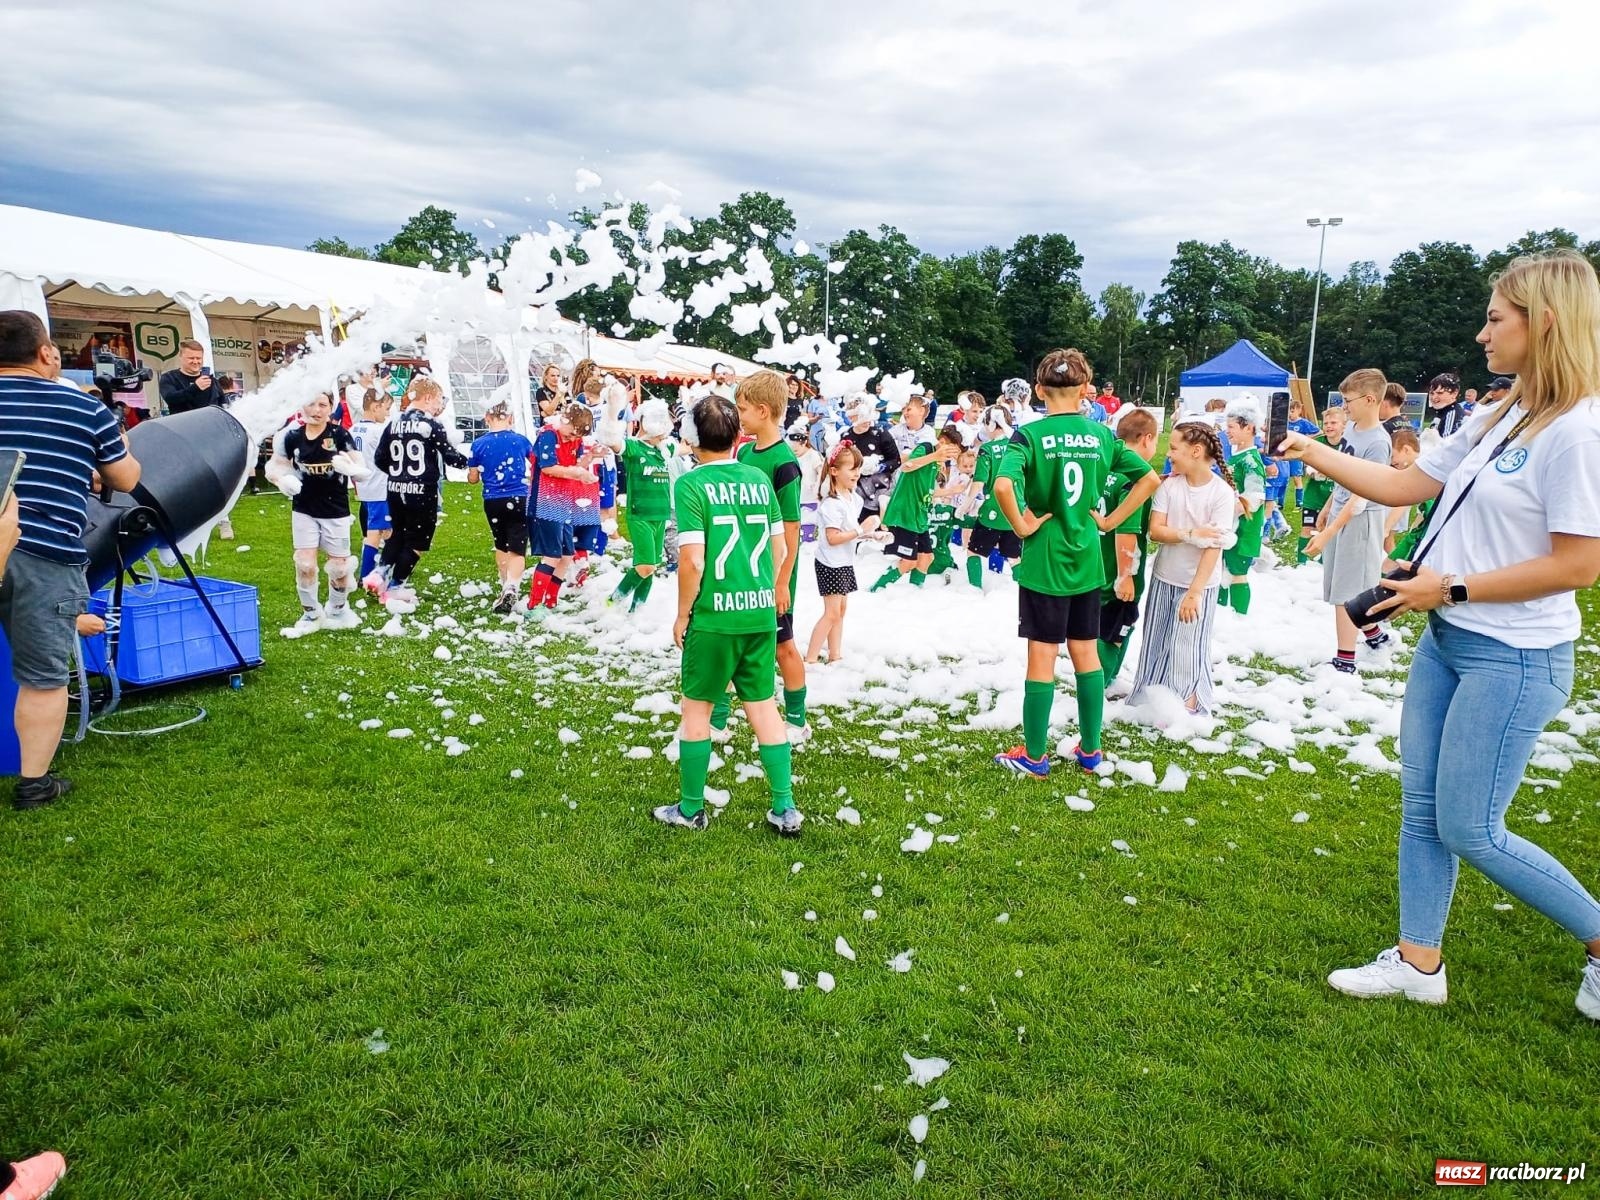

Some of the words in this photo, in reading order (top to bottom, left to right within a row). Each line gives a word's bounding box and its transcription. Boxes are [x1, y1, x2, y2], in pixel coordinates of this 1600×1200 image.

[146, 335, 170, 346] BS
[388, 439, 426, 477] 99
[704, 482, 770, 506] RAFAKO
[1063, 461, 1084, 507] 9
[712, 514, 770, 580] 77
[713, 586, 776, 612] RACIBÓR
